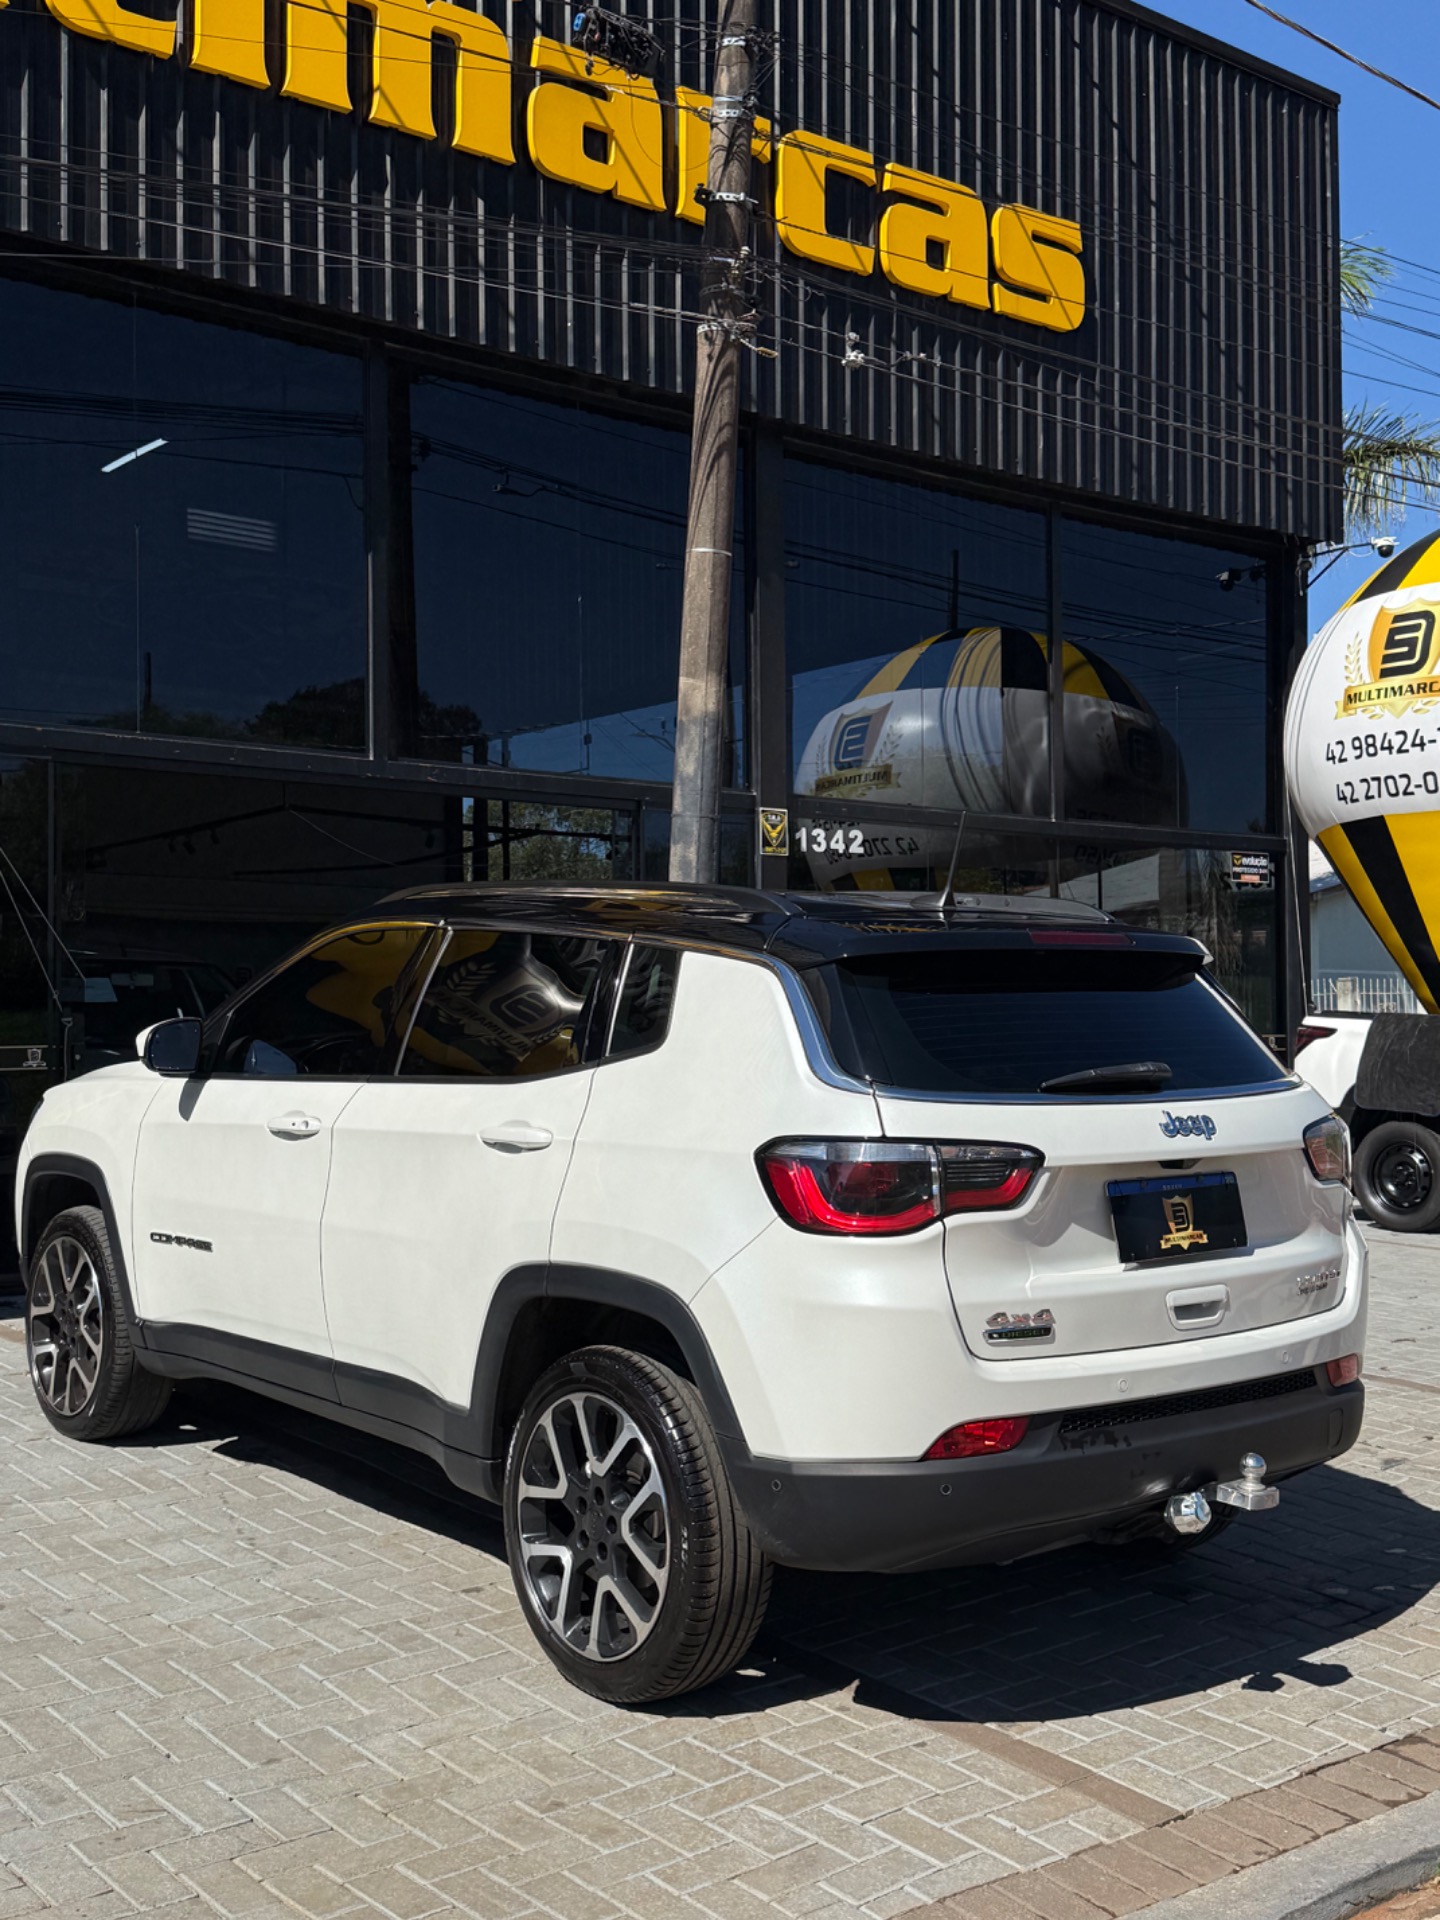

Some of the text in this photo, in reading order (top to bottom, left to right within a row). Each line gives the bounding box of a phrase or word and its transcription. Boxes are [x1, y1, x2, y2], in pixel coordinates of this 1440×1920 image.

[1346, 681, 1440, 705] MULTIMARC
[1326, 727, 1440, 765] 42 98424-
[1336, 771, 1439, 805] 42 2702-0
[795, 827, 864, 853] 1342
[1159, 1110, 1217, 1141] Jeep
[986, 1308, 1056, 1329] 4x4
